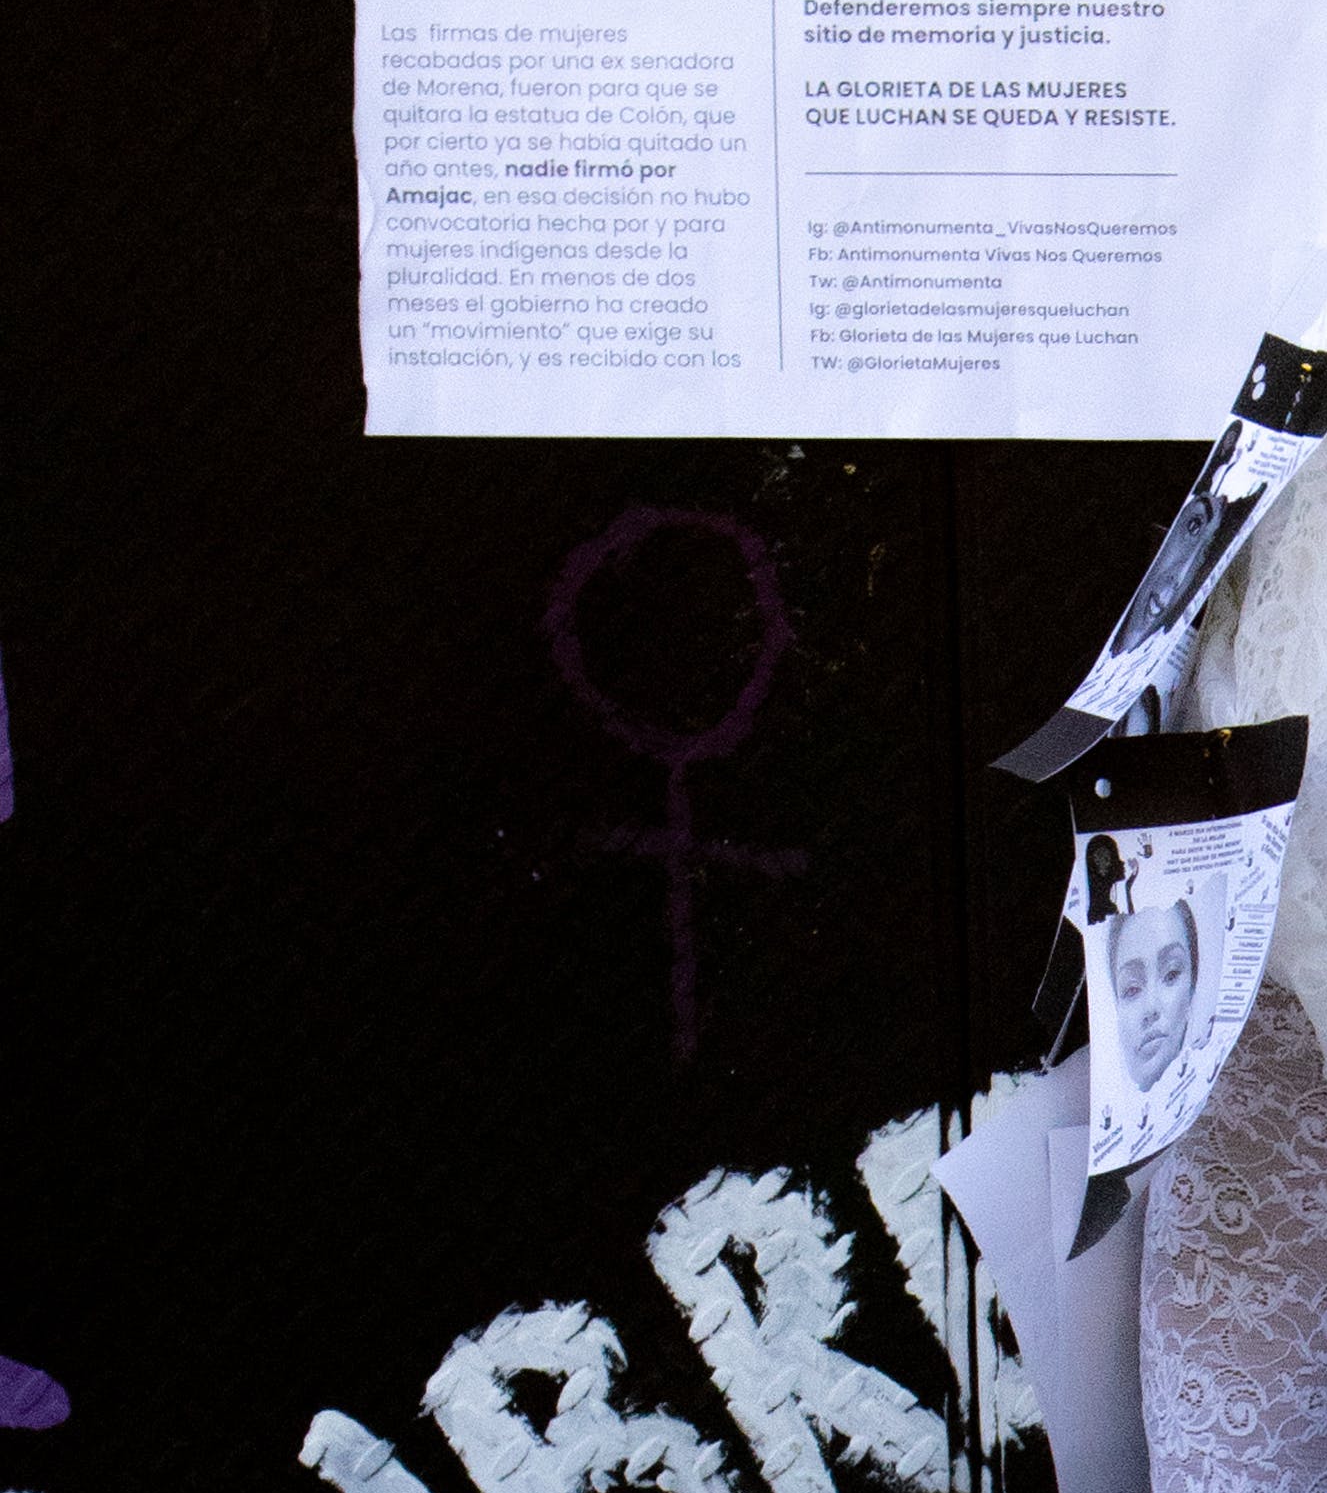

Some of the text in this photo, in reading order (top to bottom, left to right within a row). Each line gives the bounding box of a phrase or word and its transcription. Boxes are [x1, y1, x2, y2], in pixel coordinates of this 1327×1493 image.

[1076, 0, 1166, 18] nuestro
[803, 24, 1111, 50] sitio de memoria y justicia.
[805, 80, 1128, 99] LA GLORIETA DE LAS MUJERES
[805, 107, 1176, 129] QUE LUCHAN SE QUEDA Y RESISTE.
[806, 219, 1178, 240] Ig: @Antimonumenta_VivasNosQueremos
[807, 246, 1163, 265] Fb: Antimonumenta Vivas Nos Queremos
[808, 273, 1003, 293] Tw: @Antimonumenta
[808, 300, 1130, 321] Ig: @glorietadelasmujeresqueluchan
[809, 328, 1139, 348] Fb: Glorieta de las Mujeres que Luchan
[810, 354, 1001, 375] TW: @GlorietaMujeres
